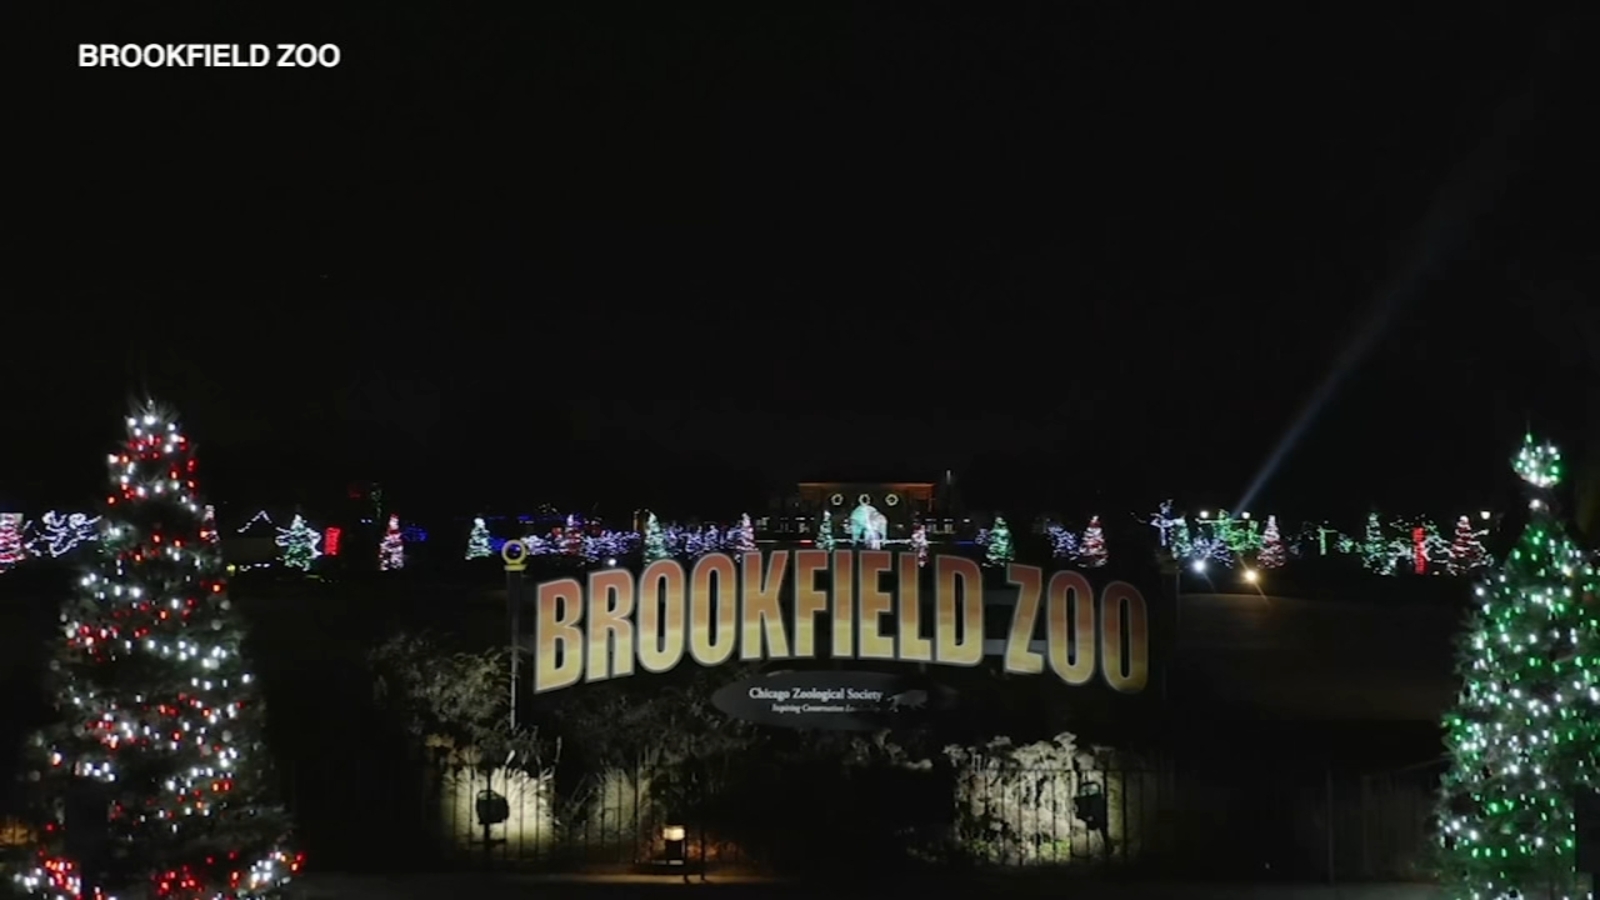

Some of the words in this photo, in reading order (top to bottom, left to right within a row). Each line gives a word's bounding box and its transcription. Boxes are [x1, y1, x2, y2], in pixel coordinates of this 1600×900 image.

[534, 549, 984, 693] BROOKFIELD
[1005, 563, 1149, 692] ZOO
[749, 687, 790, 702] Chicago
[792, 687, 845, 702] Zoological
[847, 687, 883, 702] Society
